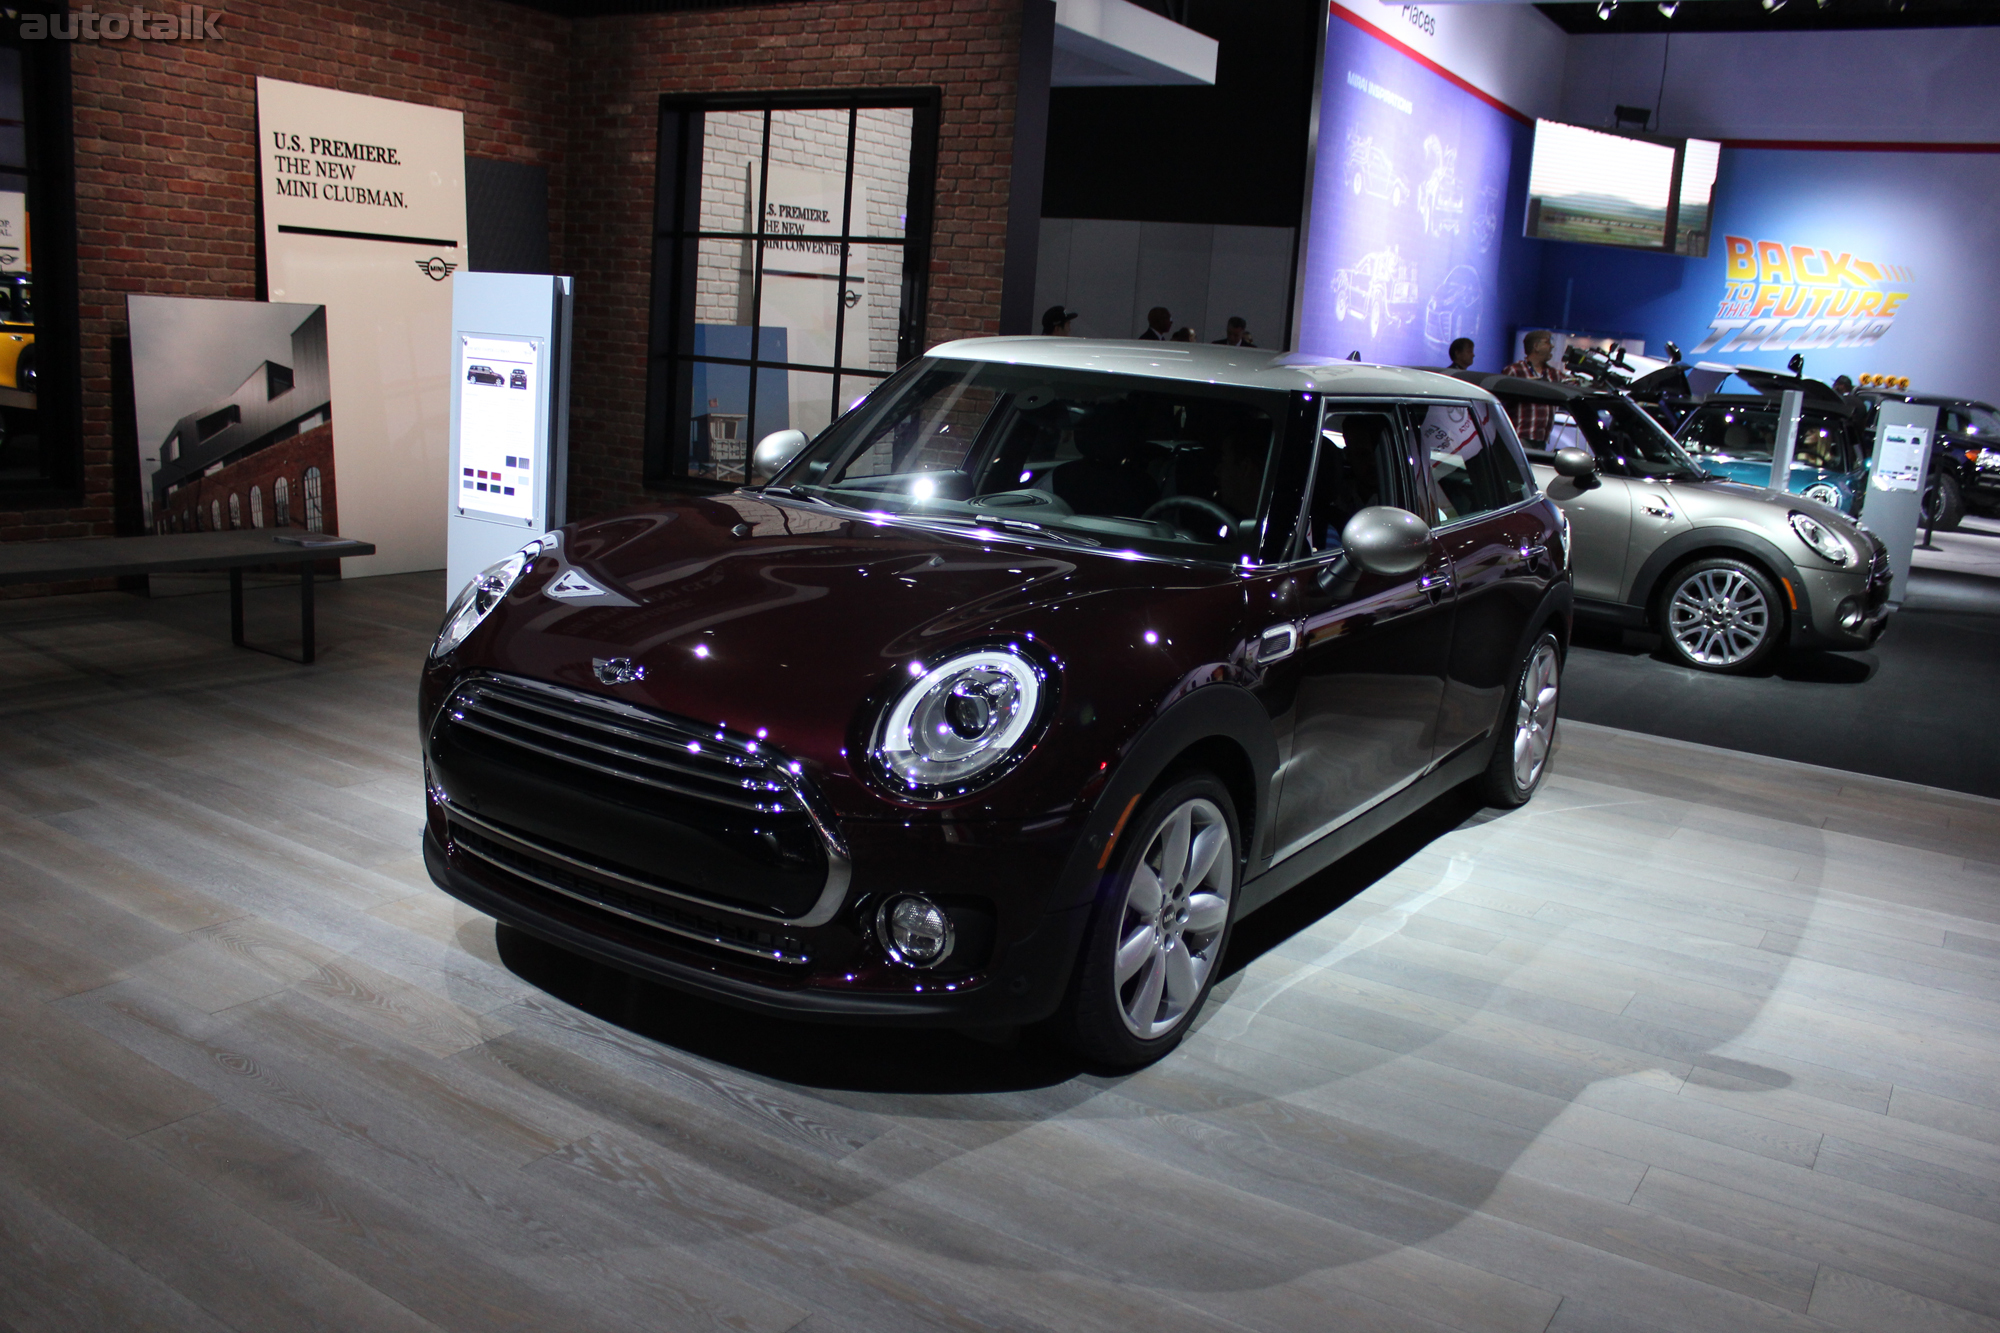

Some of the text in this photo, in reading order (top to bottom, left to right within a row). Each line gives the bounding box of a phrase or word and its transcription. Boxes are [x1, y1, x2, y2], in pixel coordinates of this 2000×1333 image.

[273, 131, 402, 166] U.S. PREMIERE.
[274, 155, 356, 181] THE NEW
[276, 178, 408, 209] MINI CLUBMAN.
[779, 204, 831, 224] PREMIERE.
[782, 221, 805, 235] NEW
[430, 265, 445, 273] MINI
[1725, 235, 1876, 288] BACK
[1717, 285, 1910, 318] THE FUTURE
[1726, 283, 1754, 300] TO
[1690, 318, 1895, 354] TACOMA
